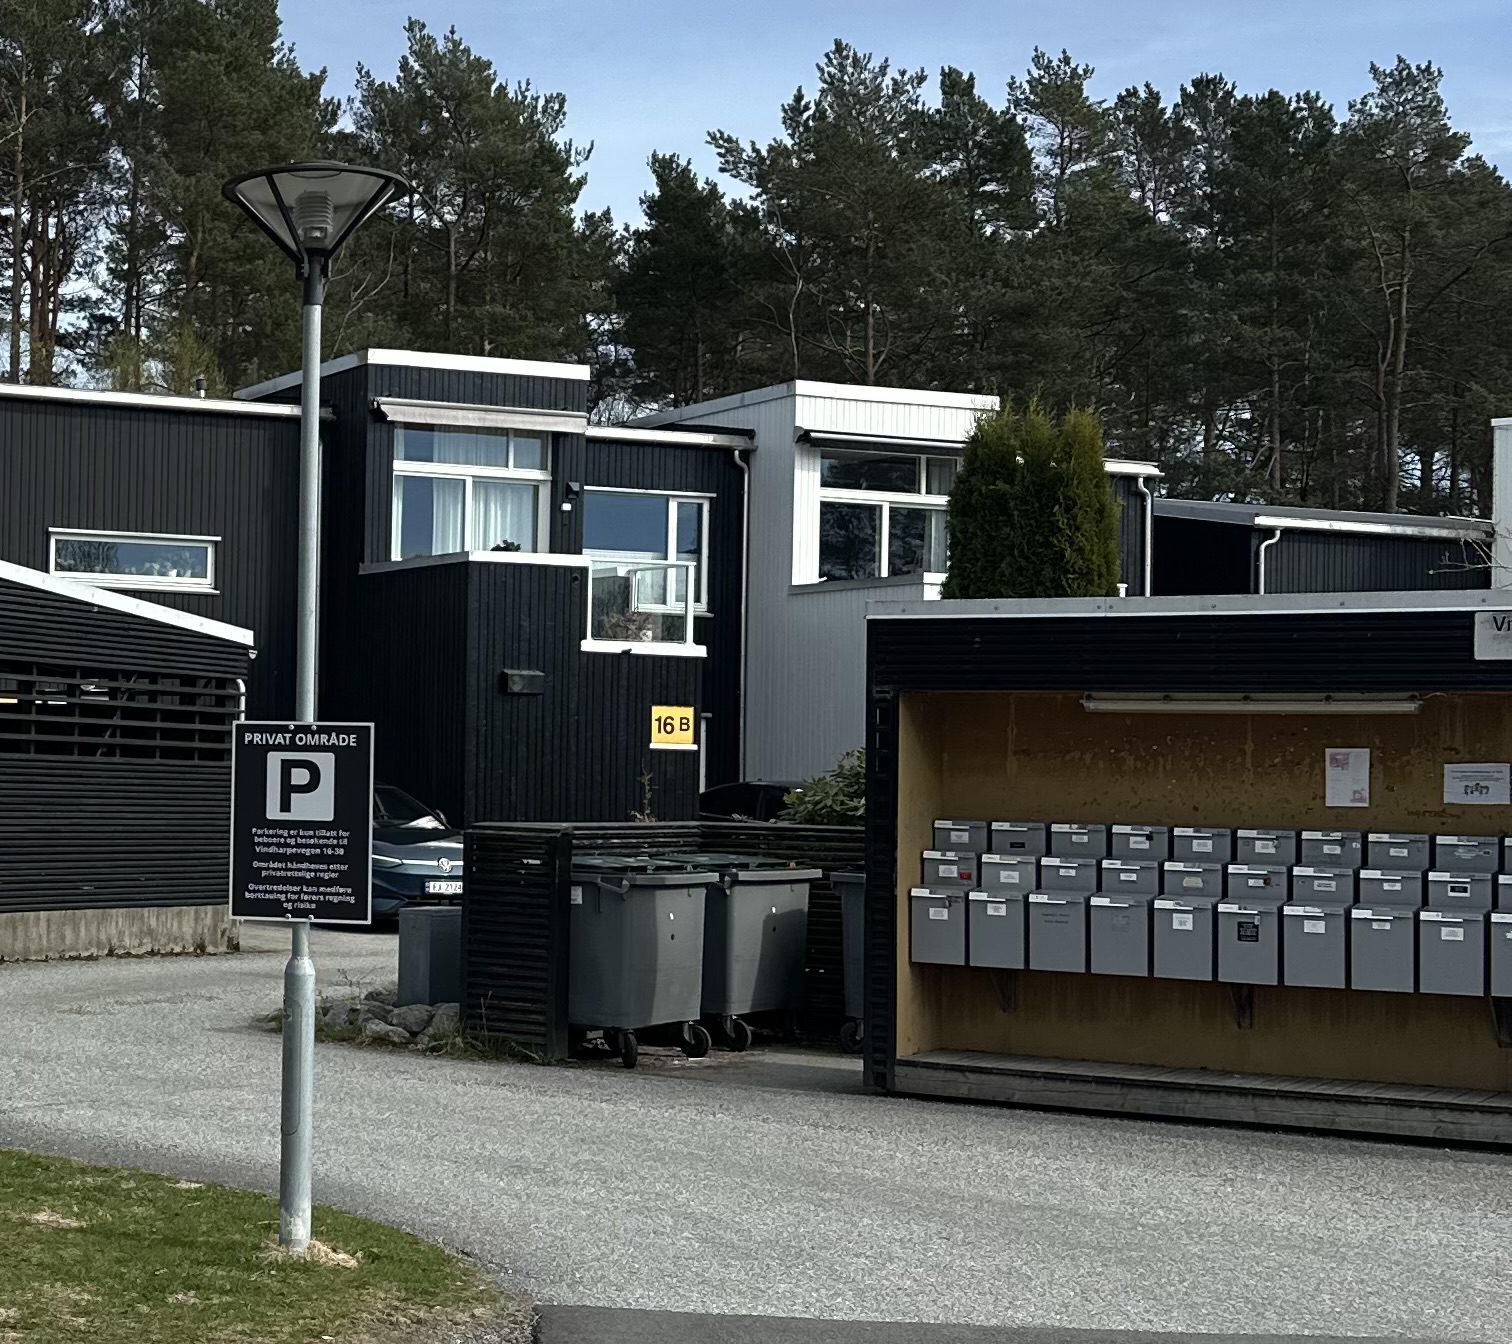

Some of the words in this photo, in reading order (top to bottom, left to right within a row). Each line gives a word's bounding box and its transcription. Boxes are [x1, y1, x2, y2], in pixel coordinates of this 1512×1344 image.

[654, 716, 675, 735] 16
[679, 717, 691, 732] B
[244, 732, 292, 745] PRIVAT
[295, 732, 358, 747] OMRÅDE
[279, 758, 321, 813] P
[252, 827, 289, 837] Parkering
[299, 828, 314, 836] kun
[315, 829, 337, 837] tillatt
[338, 829, 350, 837] for
[254, 835, 285, 844] beboere
[286, 837, 296, 845] og
[296, 836, 337, 845] besøkende
[338, 837, 348, 845] til
[254, 845, 321, 856] Vindharpevegen
[252, 860, 286, 869] Området
[286, 860, 328, 870] håndheves
[329, 863, 349, 871] etter
[261, 869, 315, 879] privatrettslige
[316, 870, 339, 880] regler
[248, 883, 301, 892] Overtredelser
[302, 884, 318, 893] kan
[318, 885, 353, 894] medføre
[244, 891, 286, 902] borttauing
[287, 892, 299, 900] for
[300, 892, 325, 901] førers
[325, 894, 356, 904] regning
[282, 902, 293, 910] og
[293, 901, 316, 909] risiko
